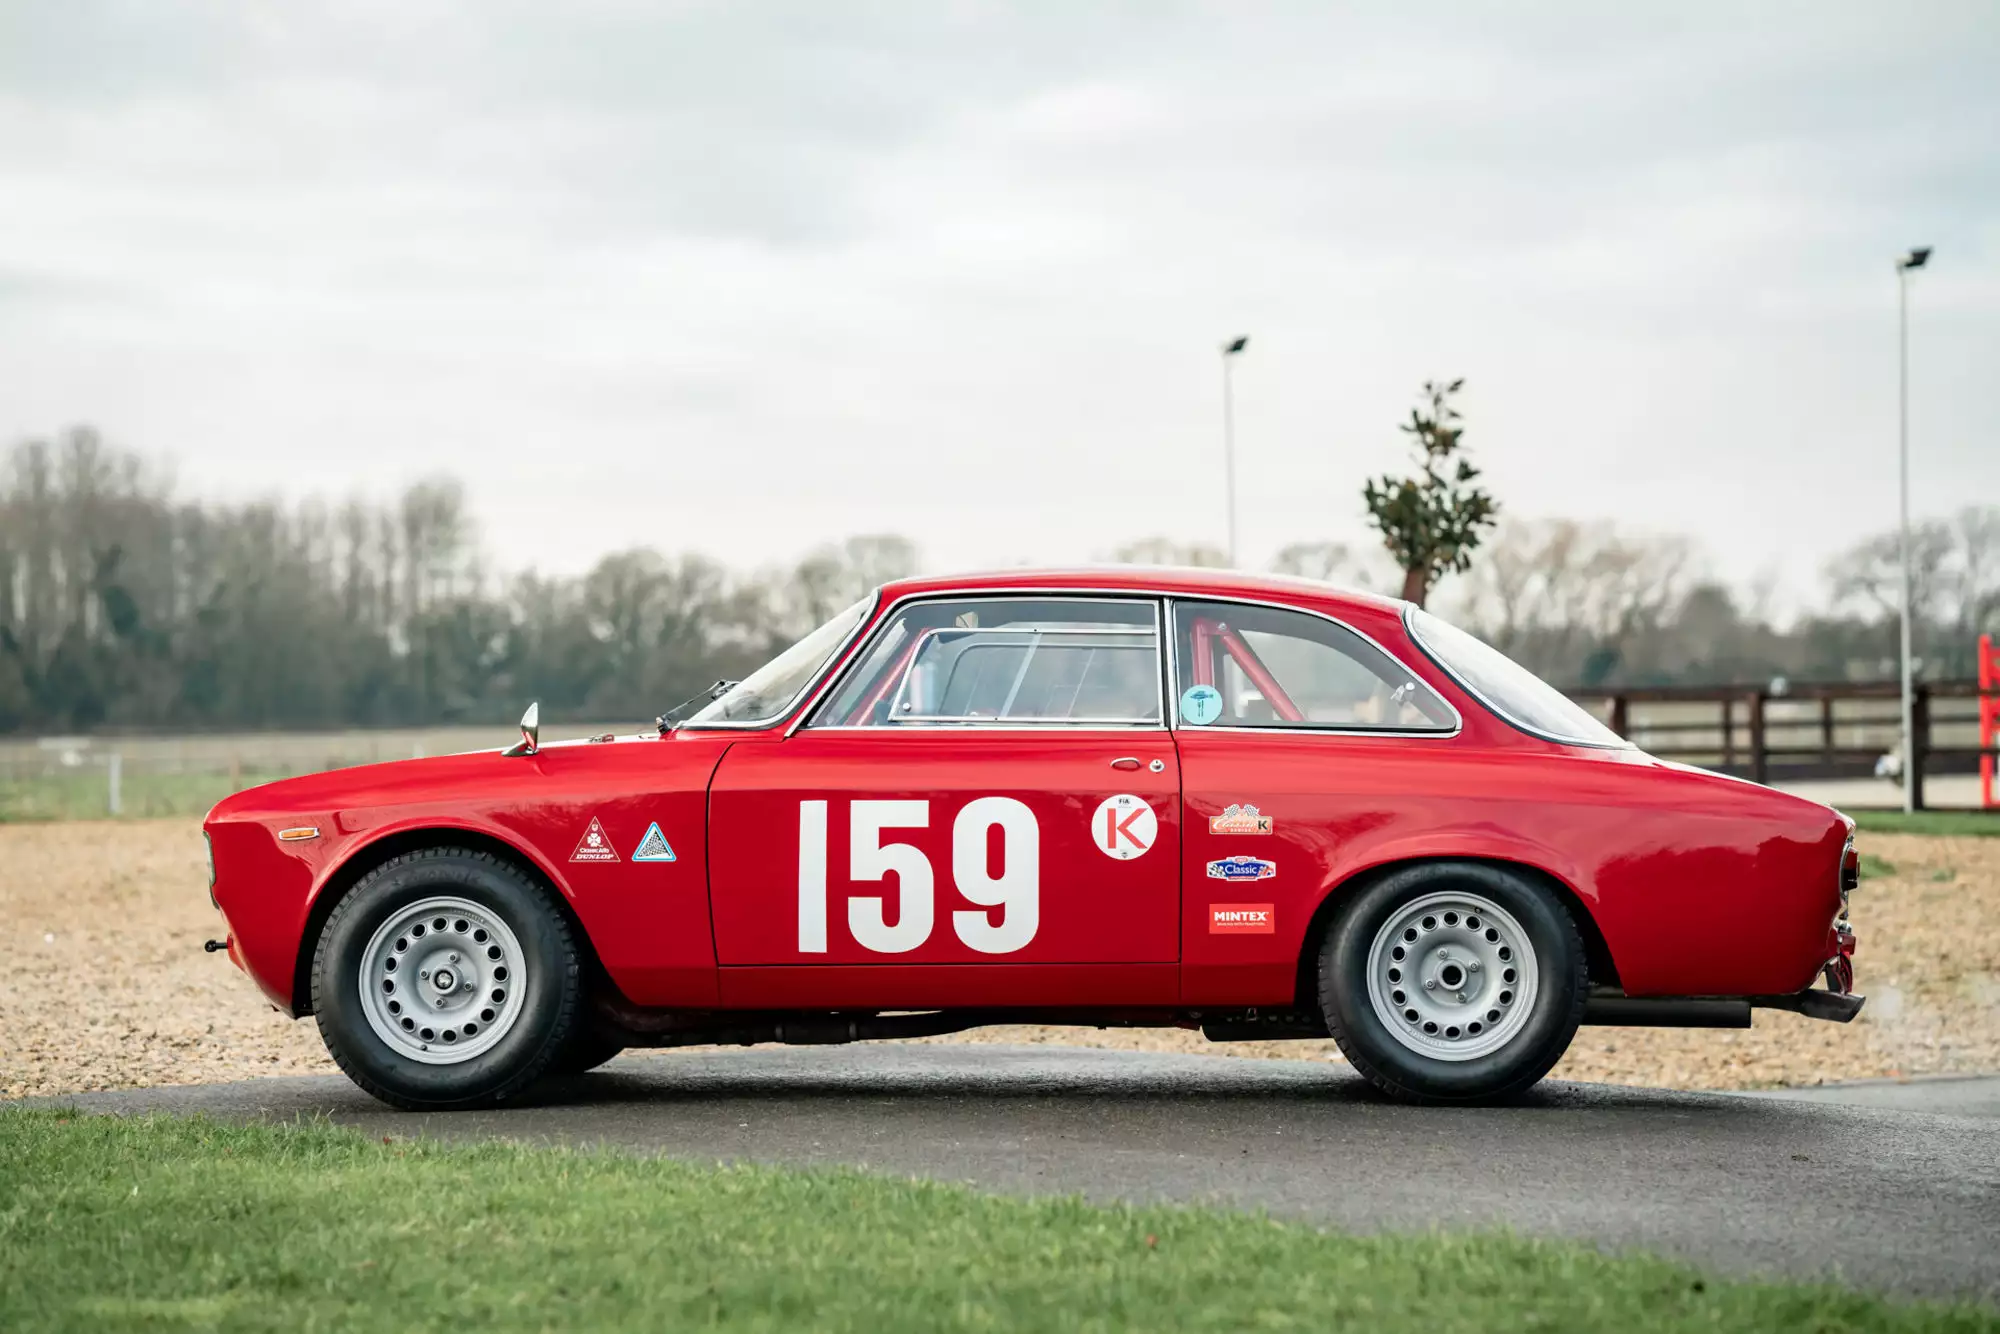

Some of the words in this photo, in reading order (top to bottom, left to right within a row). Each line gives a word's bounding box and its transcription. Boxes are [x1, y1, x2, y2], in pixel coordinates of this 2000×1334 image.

[1107, 808, 1148, 849] K
[1258, 820, 1268, 830] K
[1225, 864, 1258, 874] Classic
[798, 796, 1040, 954] 159
[1214, 911, 1267, 921] MINTEX
